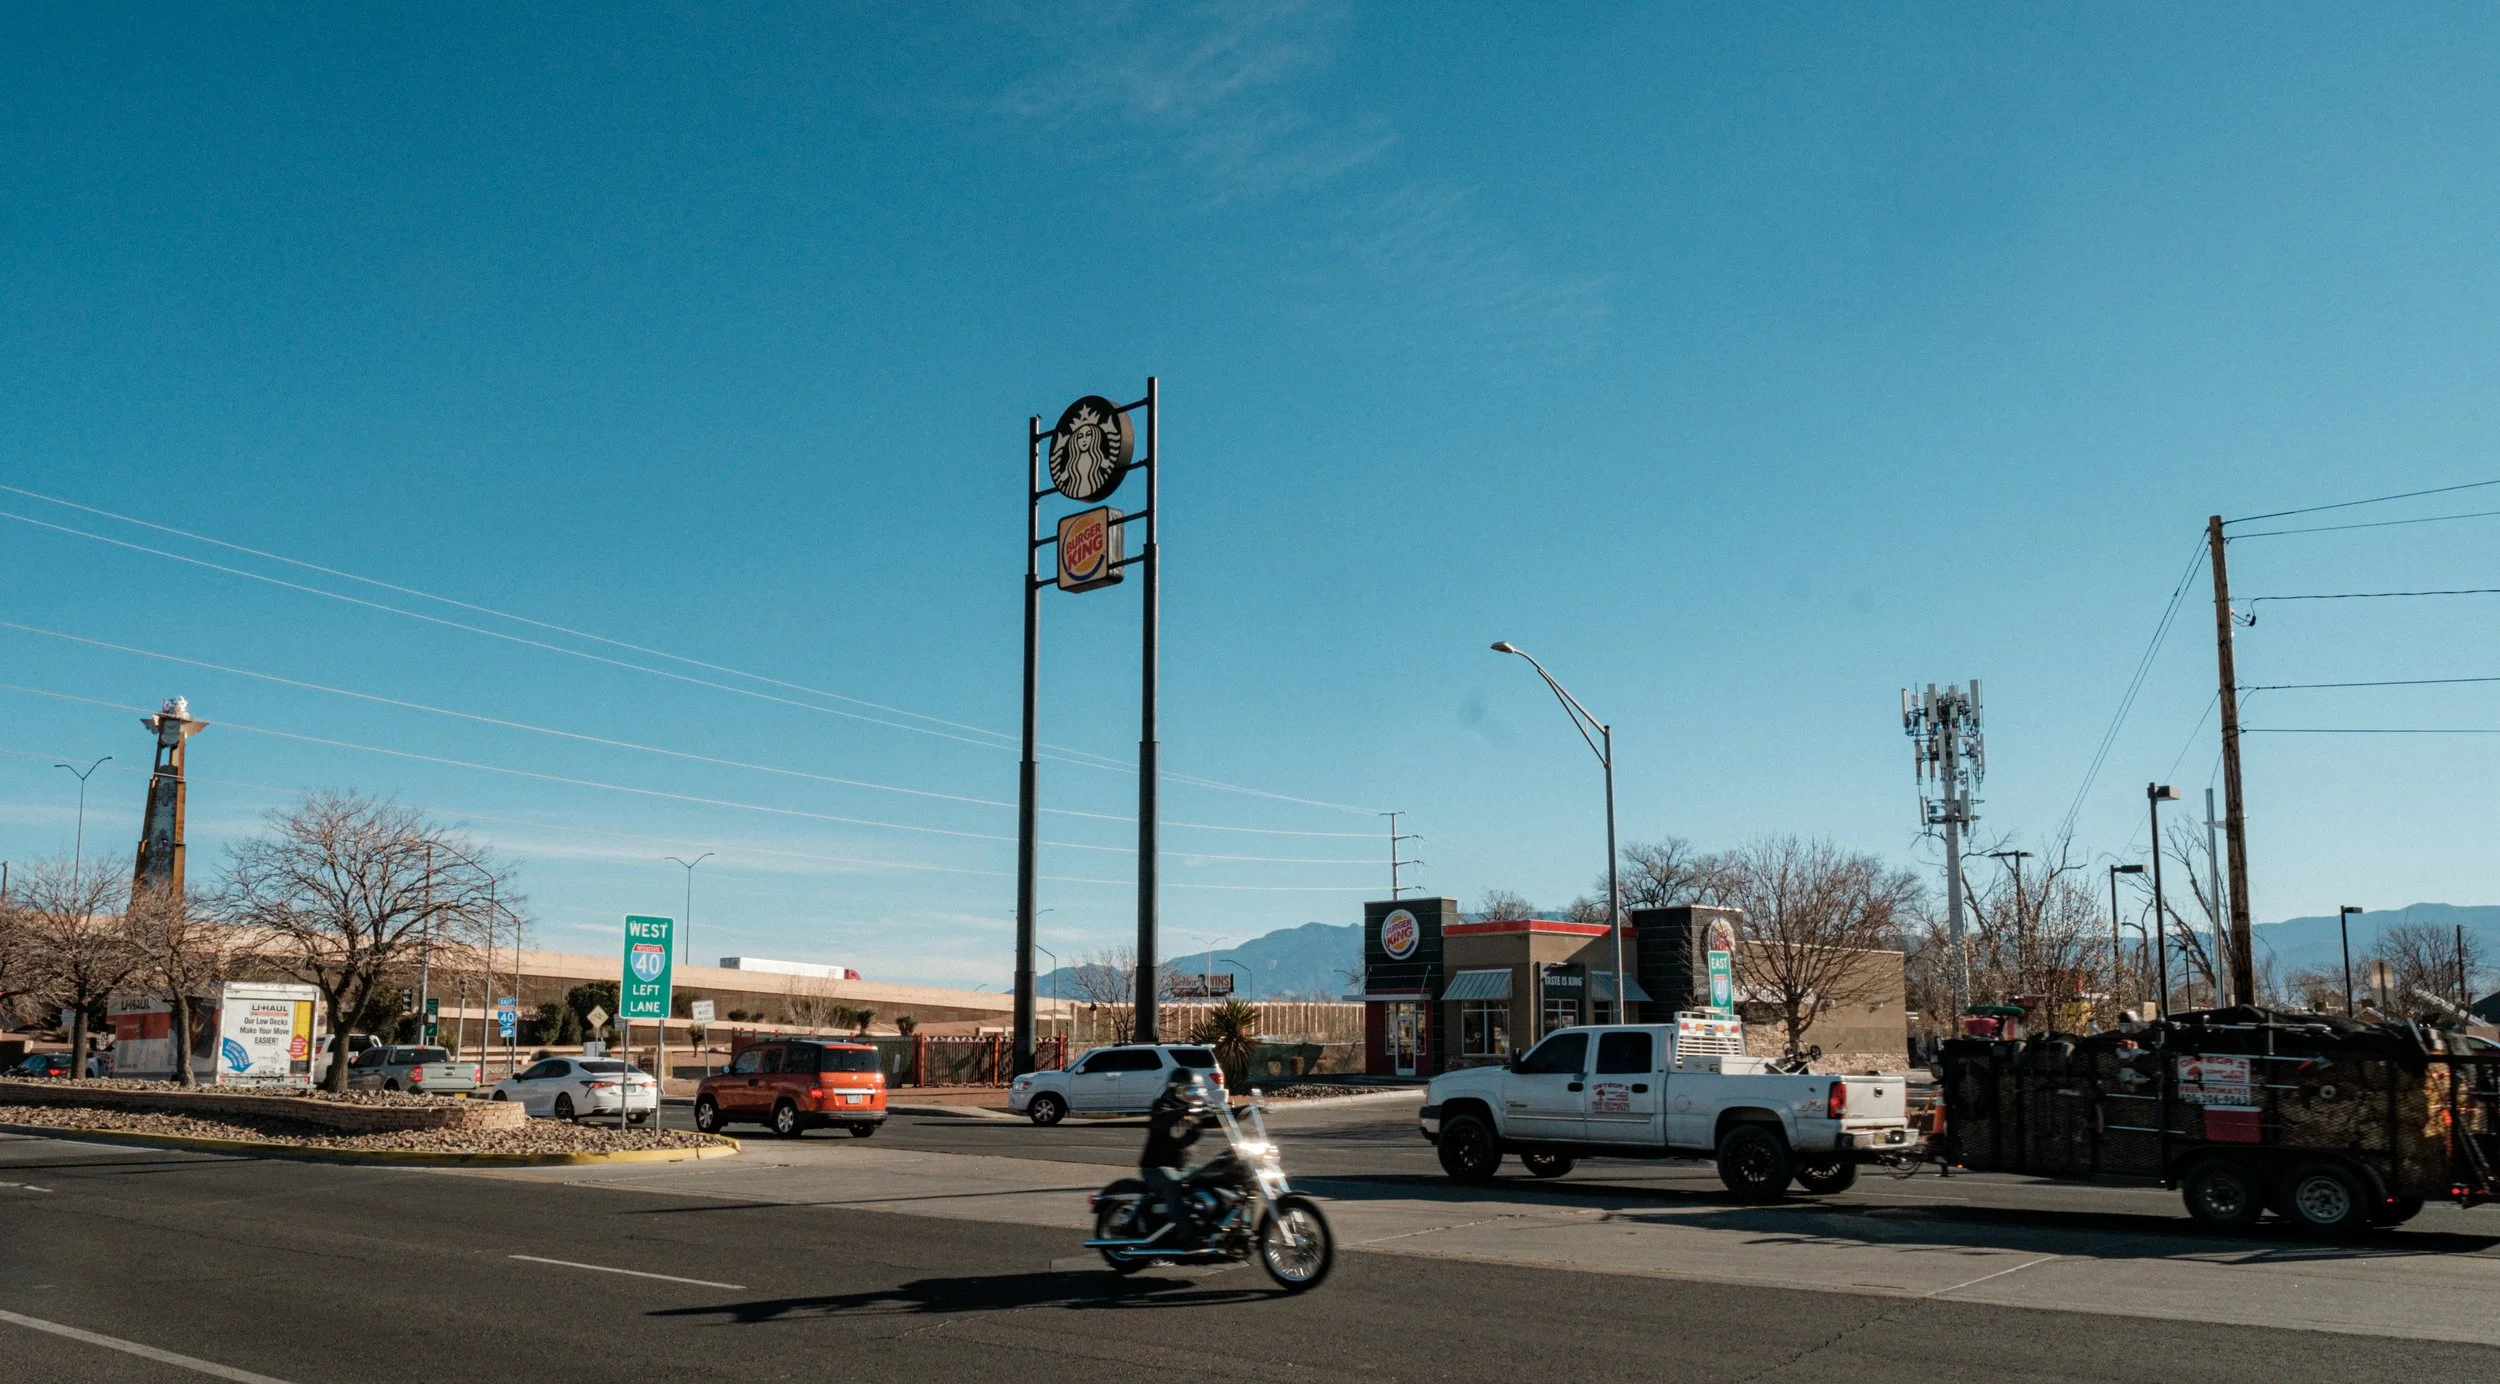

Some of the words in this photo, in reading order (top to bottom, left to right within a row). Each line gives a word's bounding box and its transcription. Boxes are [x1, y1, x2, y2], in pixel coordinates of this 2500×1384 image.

[1066, 522, 1102, 557] BURGER
[1067, 533, 1104, 571] KING
[629, 921, 668, 938] WEST
[1386, 919, 1412, 936] BURGER
[1386, 926, 1413, 948] KING
[635, 953, 661, 975] 40
[1711, 956, 1727, 970] EAST
[1544, 975, 1560, 986] TASTE
[1561, 976, 1567, 986] IS
[1568, 976, 1583, 987] KING
[632, 984, 660, 996] LEFT
[1716, 981, 1727, 994] 40
[251, 1004, 288, 1012] U-HAUL
[630, 1001, 661, 1013] LANE
[244, 1017, 255, 1025] Our
[256, 1017, 268, 1025] Low
[269, 1017, 289, 1026] Decks
[500, 1012, 515, 1022] 40
[259, 1027, 272, 1035] Your
[273, 1027, 290, 1035] Move
[254, 1036, 279, 1045] EASIER!
